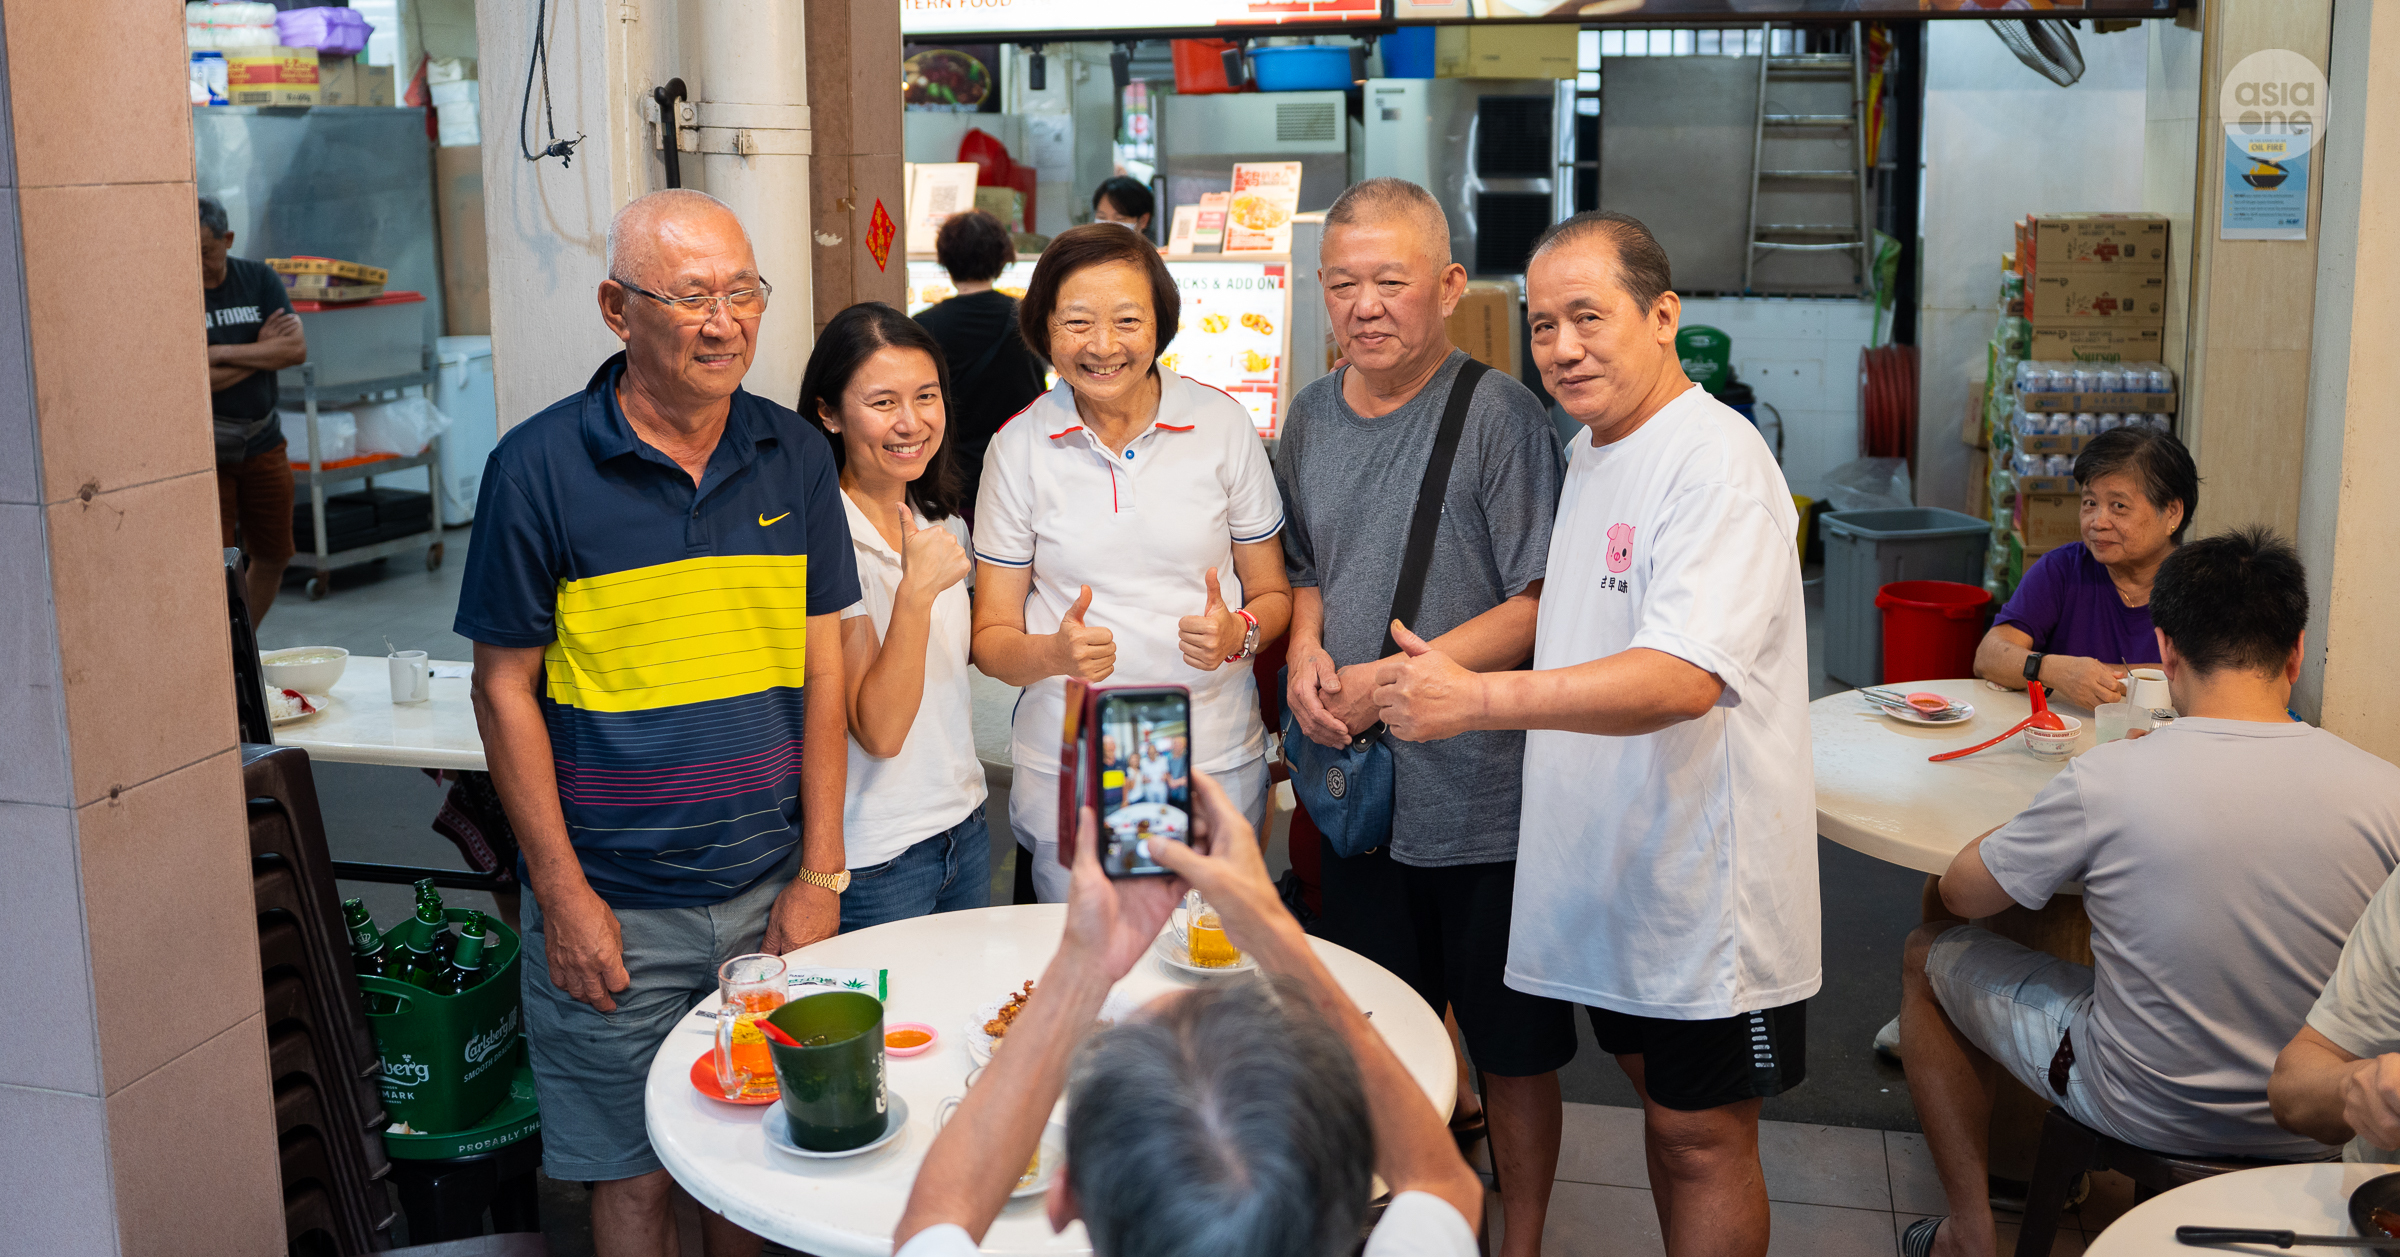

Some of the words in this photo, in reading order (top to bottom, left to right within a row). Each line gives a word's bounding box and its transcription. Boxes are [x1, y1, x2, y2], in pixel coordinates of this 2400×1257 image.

[2251, 143, 2264, 151] OIL
[2266, 143, 2284, 151] FIRE
[1212, 277, 1221, 290] &
[1226, 277, 1253, 290] ADD
[1257, 277, 1275, 290] ON
[464, 1021, 509, 1063] Carlsberg
[463, 1057, 493, 1083] SMOOTH
[458, 1129, 520, 1153] PROBABLY
[522, 1120, 541, 1134] THE
